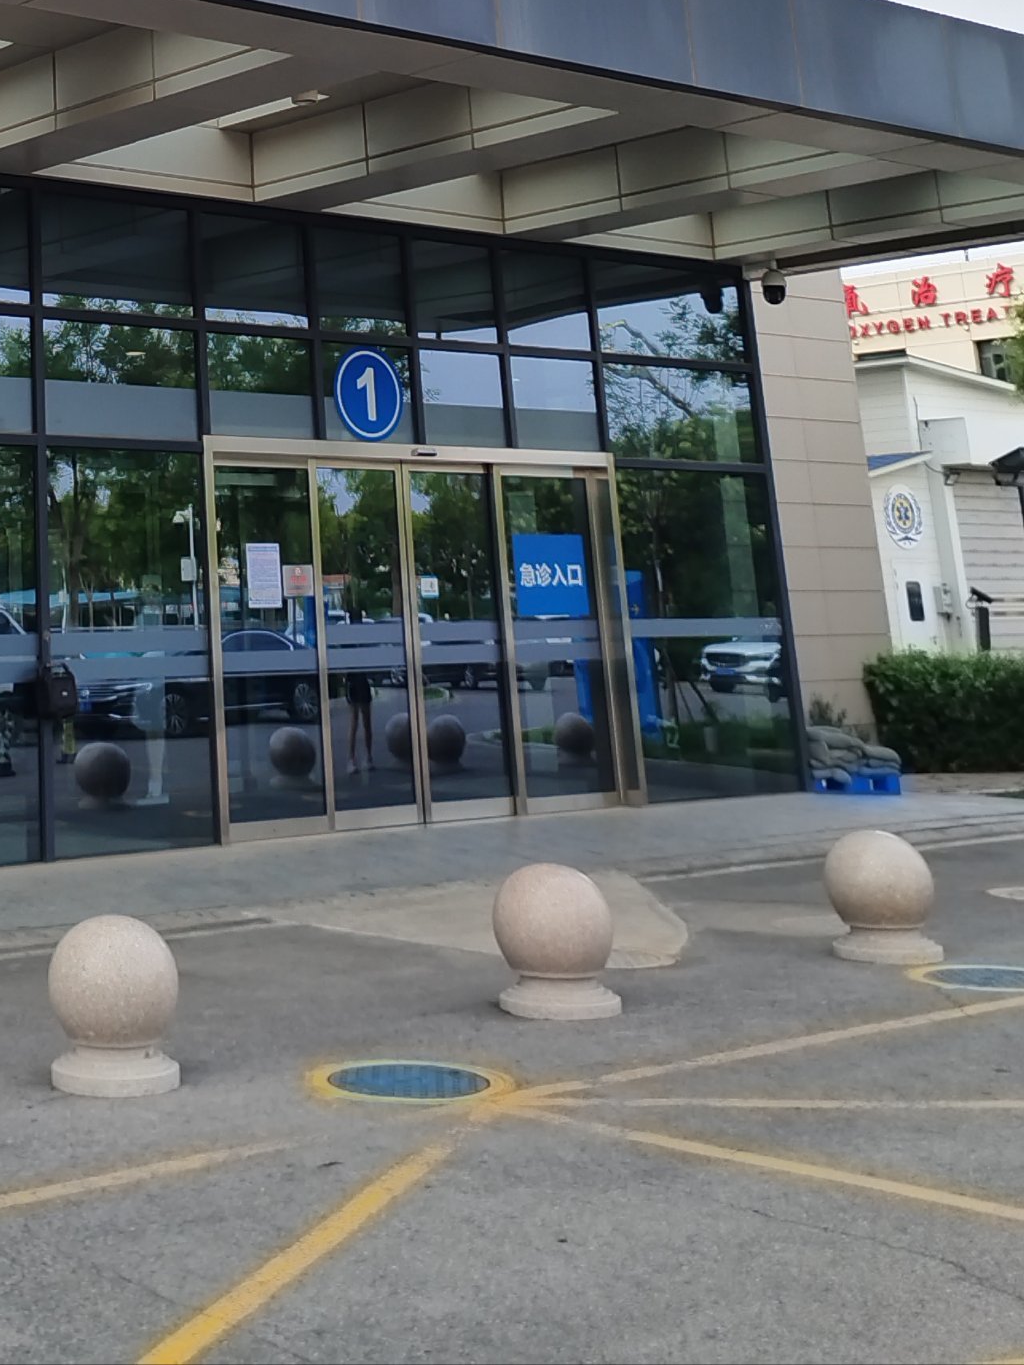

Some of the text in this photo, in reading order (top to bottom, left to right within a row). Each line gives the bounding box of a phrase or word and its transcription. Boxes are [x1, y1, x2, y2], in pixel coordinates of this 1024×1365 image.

[357, 367, 376, 421] 1
[519, 562, 583, 587] 急诊入口
